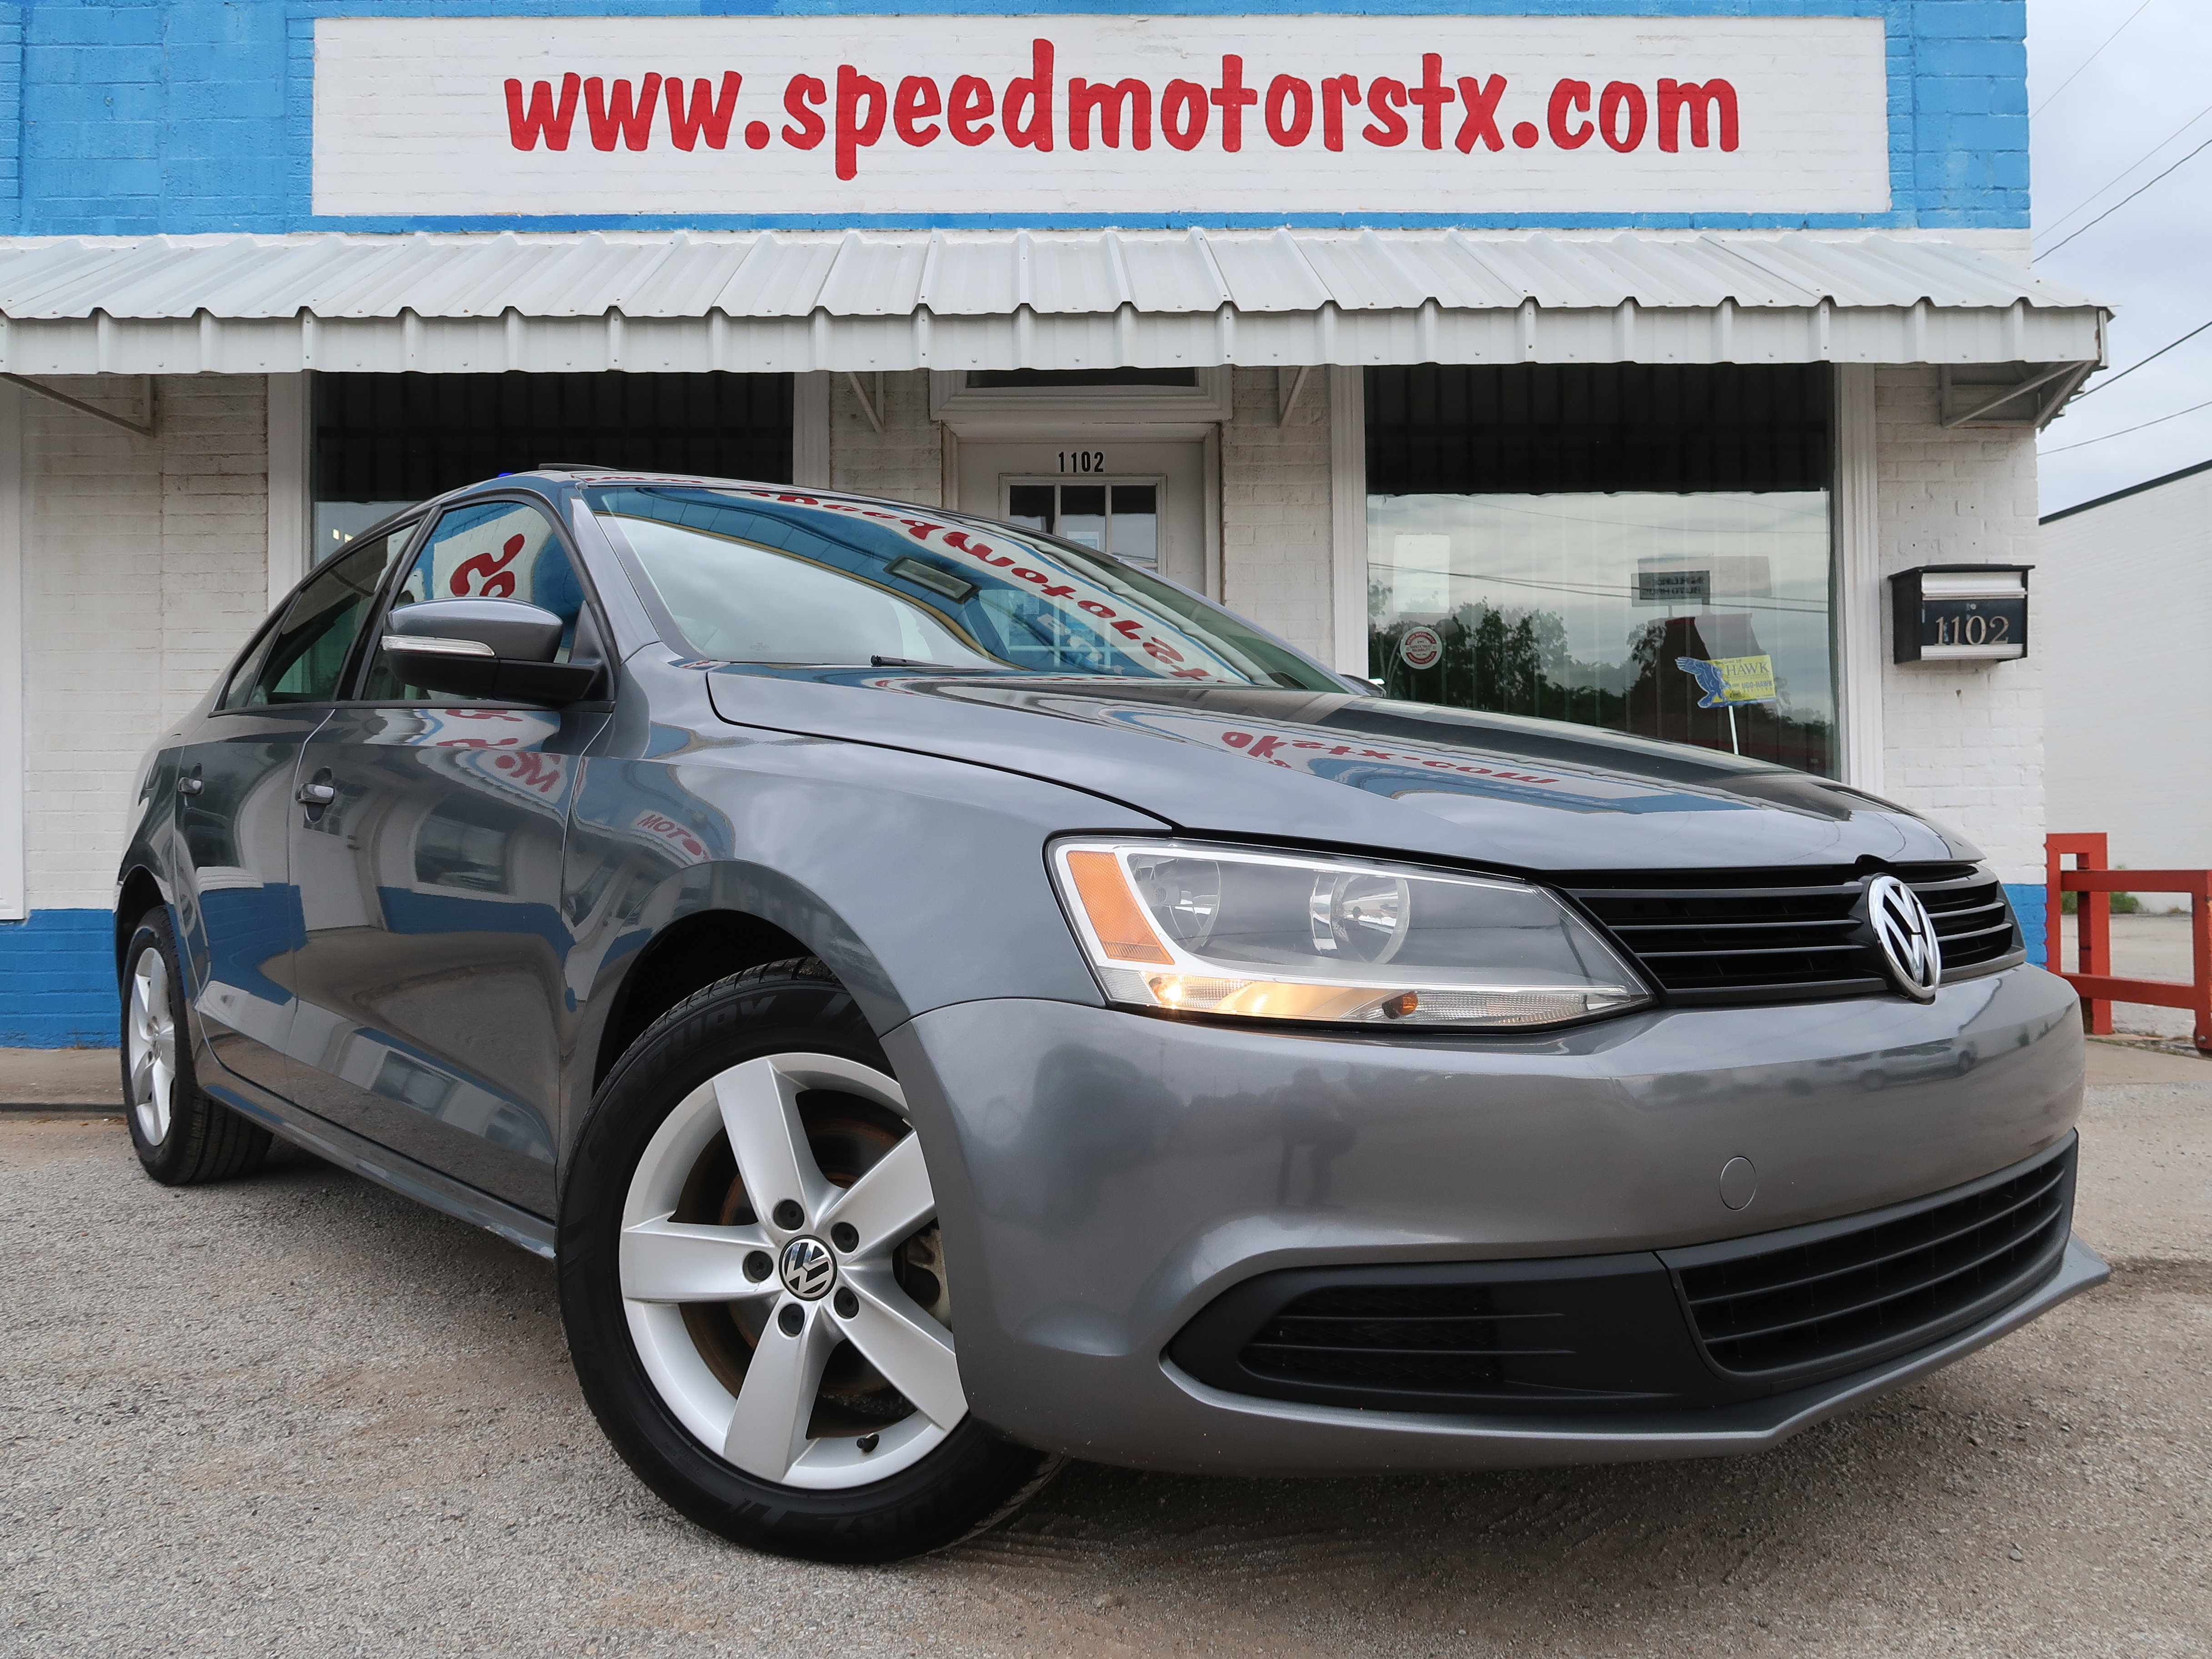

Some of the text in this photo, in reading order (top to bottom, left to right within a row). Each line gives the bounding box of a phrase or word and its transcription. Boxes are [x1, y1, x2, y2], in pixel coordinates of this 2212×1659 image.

[504, 39, 1738, 180] www.speedmotorstx.com
[1058, 452, 1104, 473] 1102
[1935, 616, 2009, 646] 1102
[1726, 662, 1770, 676] HAWK
